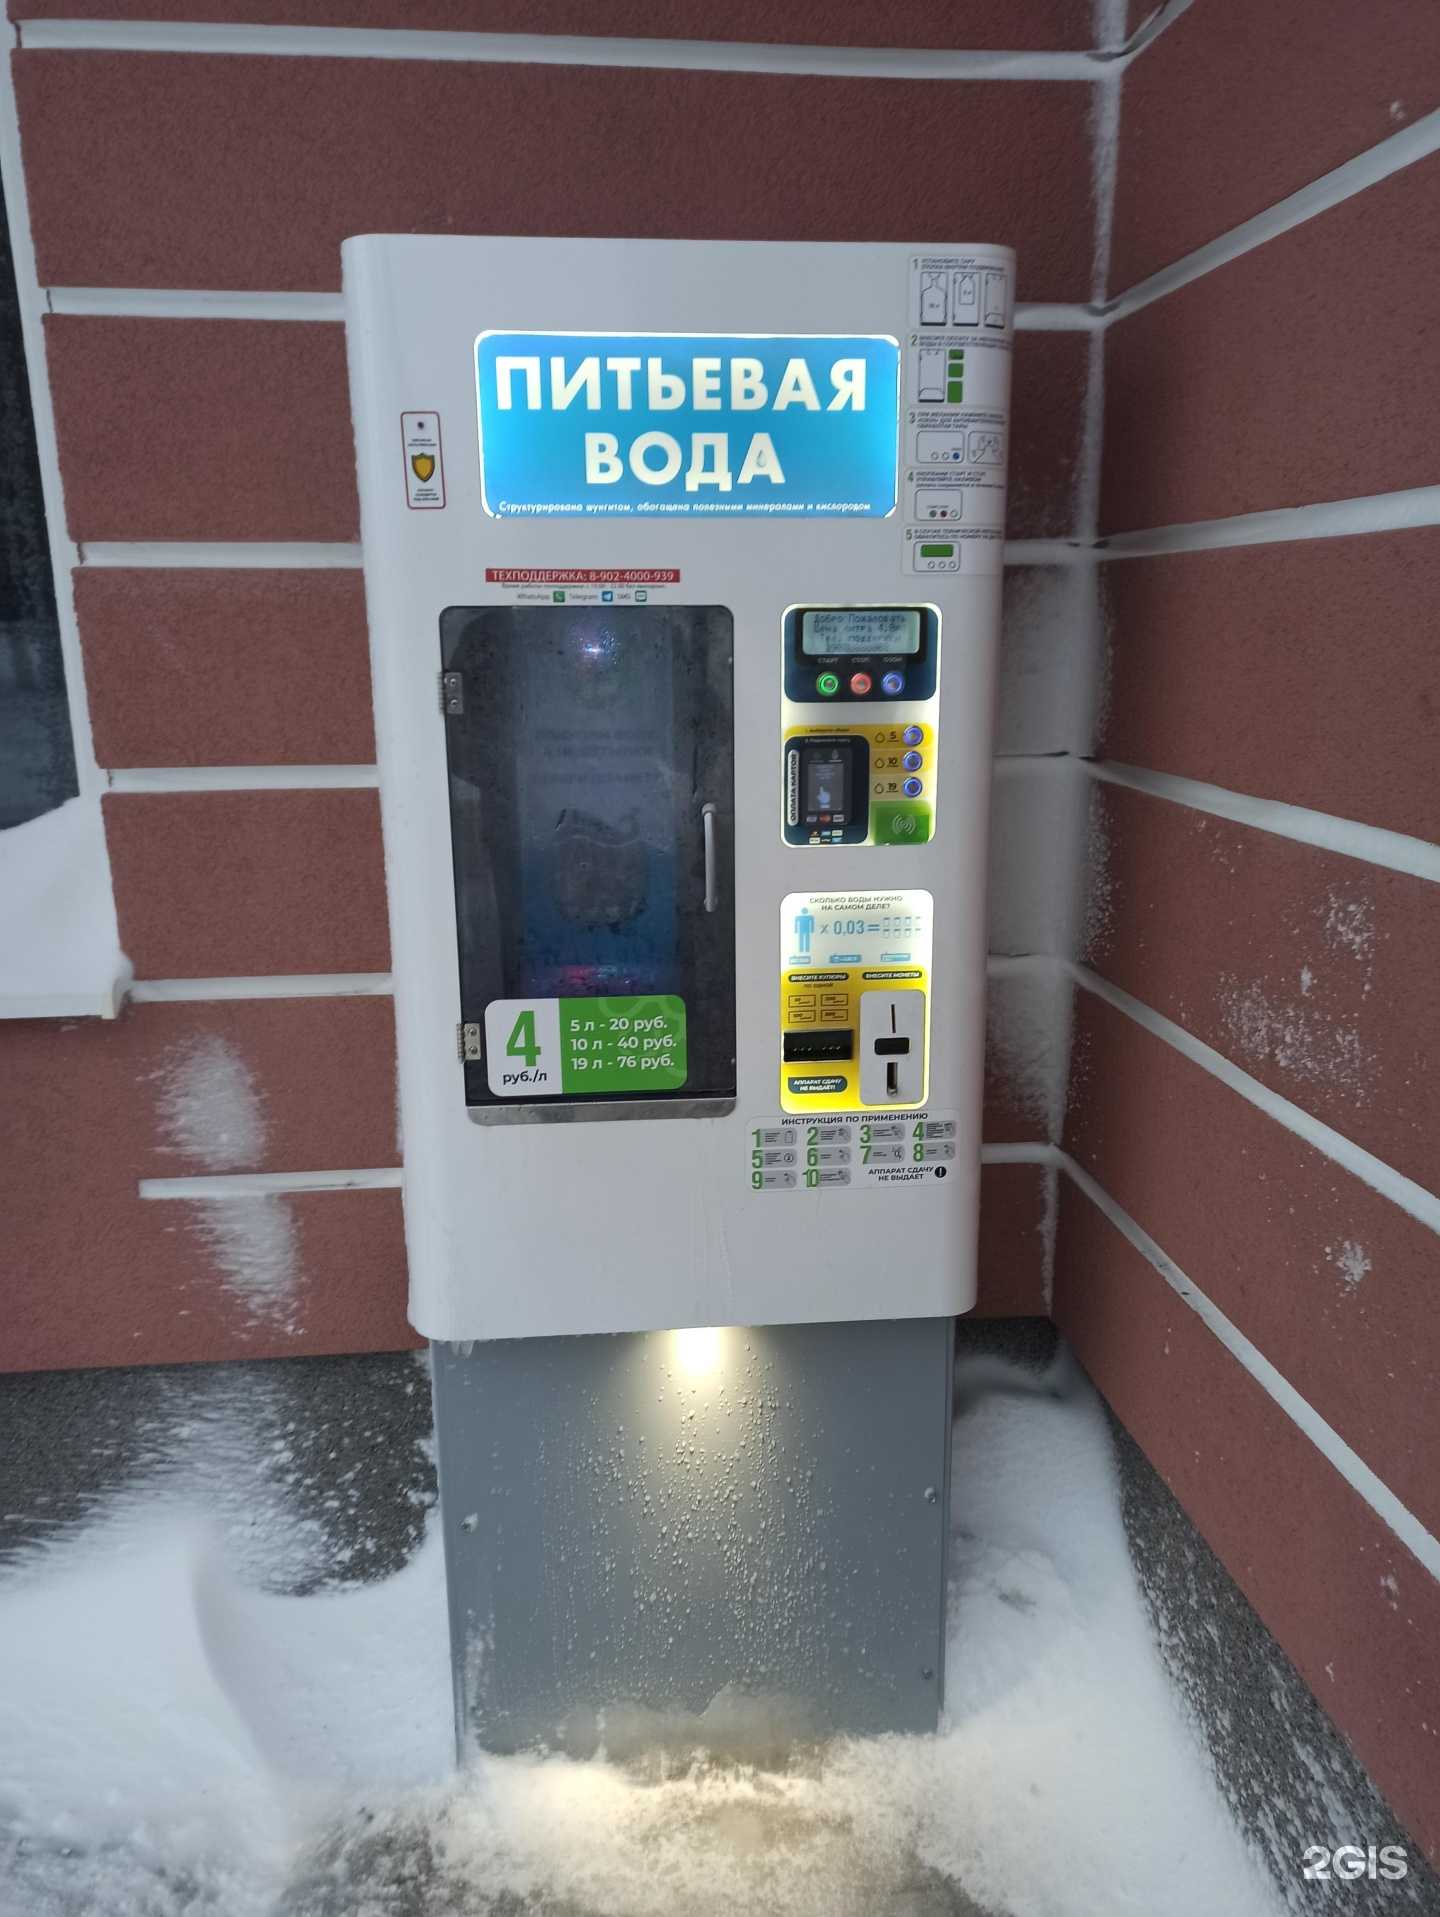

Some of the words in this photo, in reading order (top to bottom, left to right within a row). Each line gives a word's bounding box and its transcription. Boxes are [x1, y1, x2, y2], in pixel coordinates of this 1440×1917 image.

[495, 355, 867, 412] ПИТЬЕВАЯ
[585, 431, 786, 492] ВОДА
[816, 502, 871, 513] кислородом
[492, 570, 587, 582] ТЕХПОДДЕРЖКА:
[589, 570, 674, 582] 8-902-4000-939
[814, 613, 845, 624] Добро
[889, 731, 898, 739] 5
[888, 757, 898, 765] 10
[888, 782, 898, 790] 19
[833, 919, 865, 936] 0,03
[570, 1019, 580, 1032] 5
[584, 1020, 595, 1031] л
[609, 1018, 629, 1031] 20
[633, 1016, 668, 1032] руб.
[506, 1010, 542, 1067] 4
[571, 1038, 588, 1050] 10
[592, 1039, 603, 1050] л
[617, 1036, 639, 1049] 40
[643, 1035, 677, 1050] руб.
[571, 1058, 588, 1070] 19
[592, 1059, 603, 1069] л
[617, 1055, 637, 1068] 76
[640, 1054, 675, 1070] руб.
[503, 1069, 548, 1085] руб./л
[781, 1117, 844, 1126] ИНСТРУКЦИЯ
[845, 1115, 860, 1123] ПО
[861, 1113, 928, 1122] ПРИМЕНЕНИЮ
[752, 1129, 761, 1148] 1
[807, 1127, 819, 1146] 2
[860, 1124, 872, 1143] 3
[912, 1122, 925, 1141] 4
[752, 1149, 763, 1168] 5
[807, 1148, 818, 1166] 6
[860, 1145, 872, 1164] 7
[913, 1143, 924, 1162] 8
[803, 1169, 819, 1188] 10
[868, 1167, 906, 1175] АППАРАТ
[907, 1166, 934, 1174] СДАЧУ
[752, 1171, 763, 1189] 9
